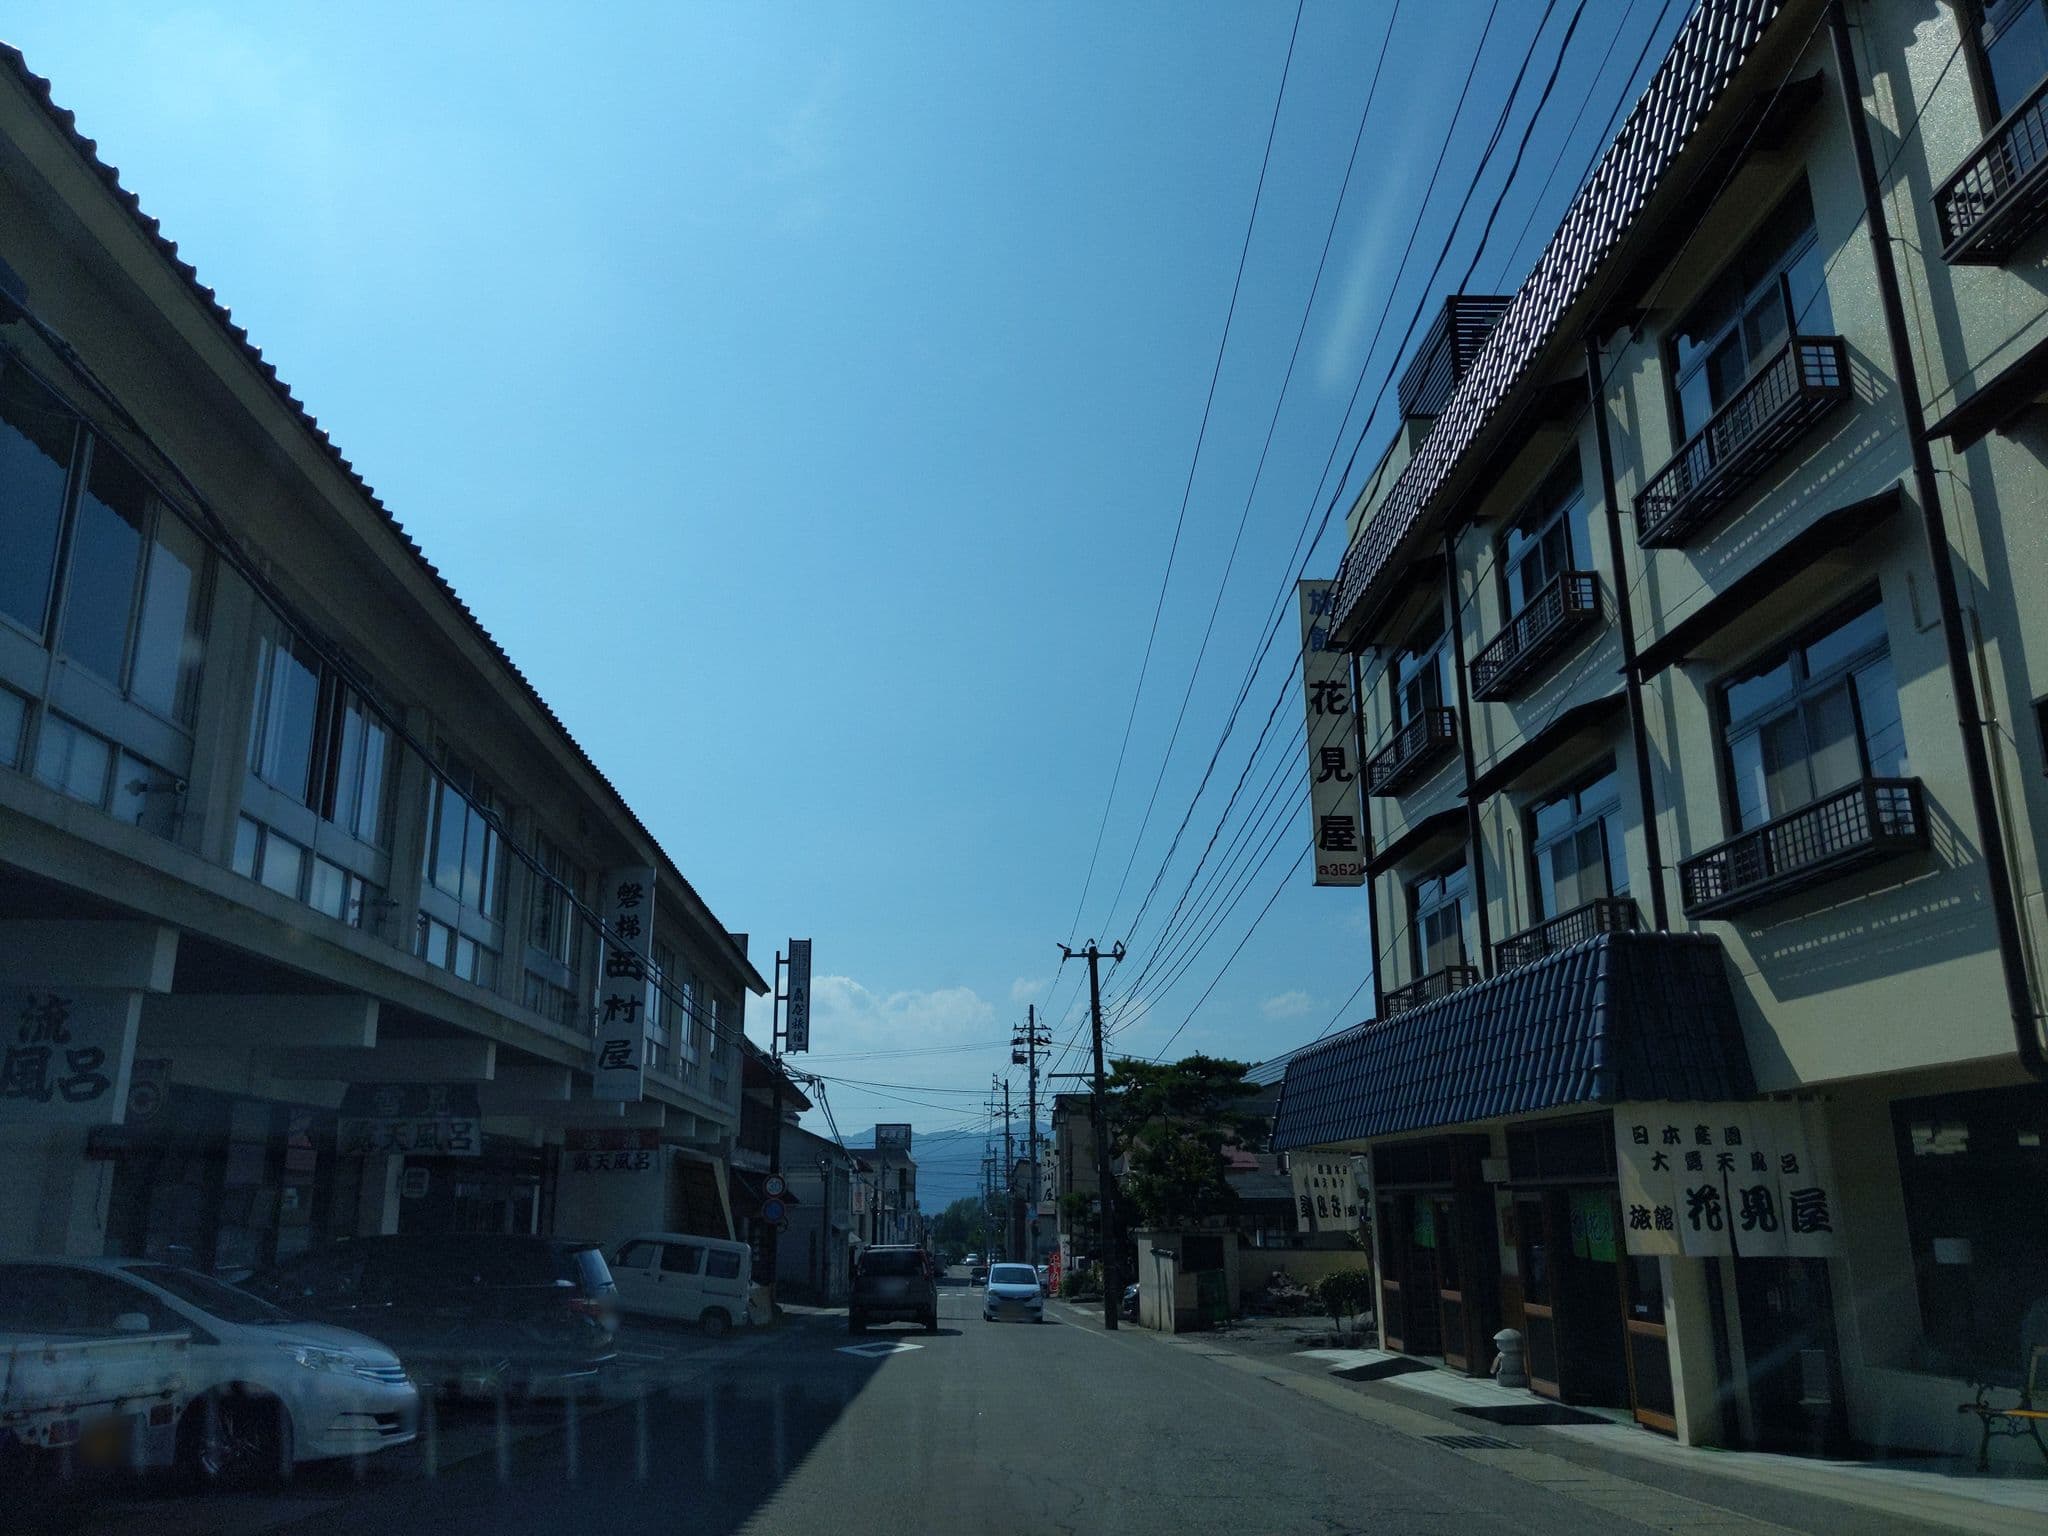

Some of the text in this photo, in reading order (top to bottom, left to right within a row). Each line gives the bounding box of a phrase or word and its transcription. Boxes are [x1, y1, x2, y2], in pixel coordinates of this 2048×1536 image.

[1310, 680, 1357, 852] 花見屋
[0, 1046, 111, 1102] 風呂
[1632, 1124, 1742, 1146] 日本庭園
[1651, 1150, 1799, 1174] 大露天風呂
[1630, 1204, 1673, 1231] 旅館
[1686, 1184, 1832, 1234] 花見屋
